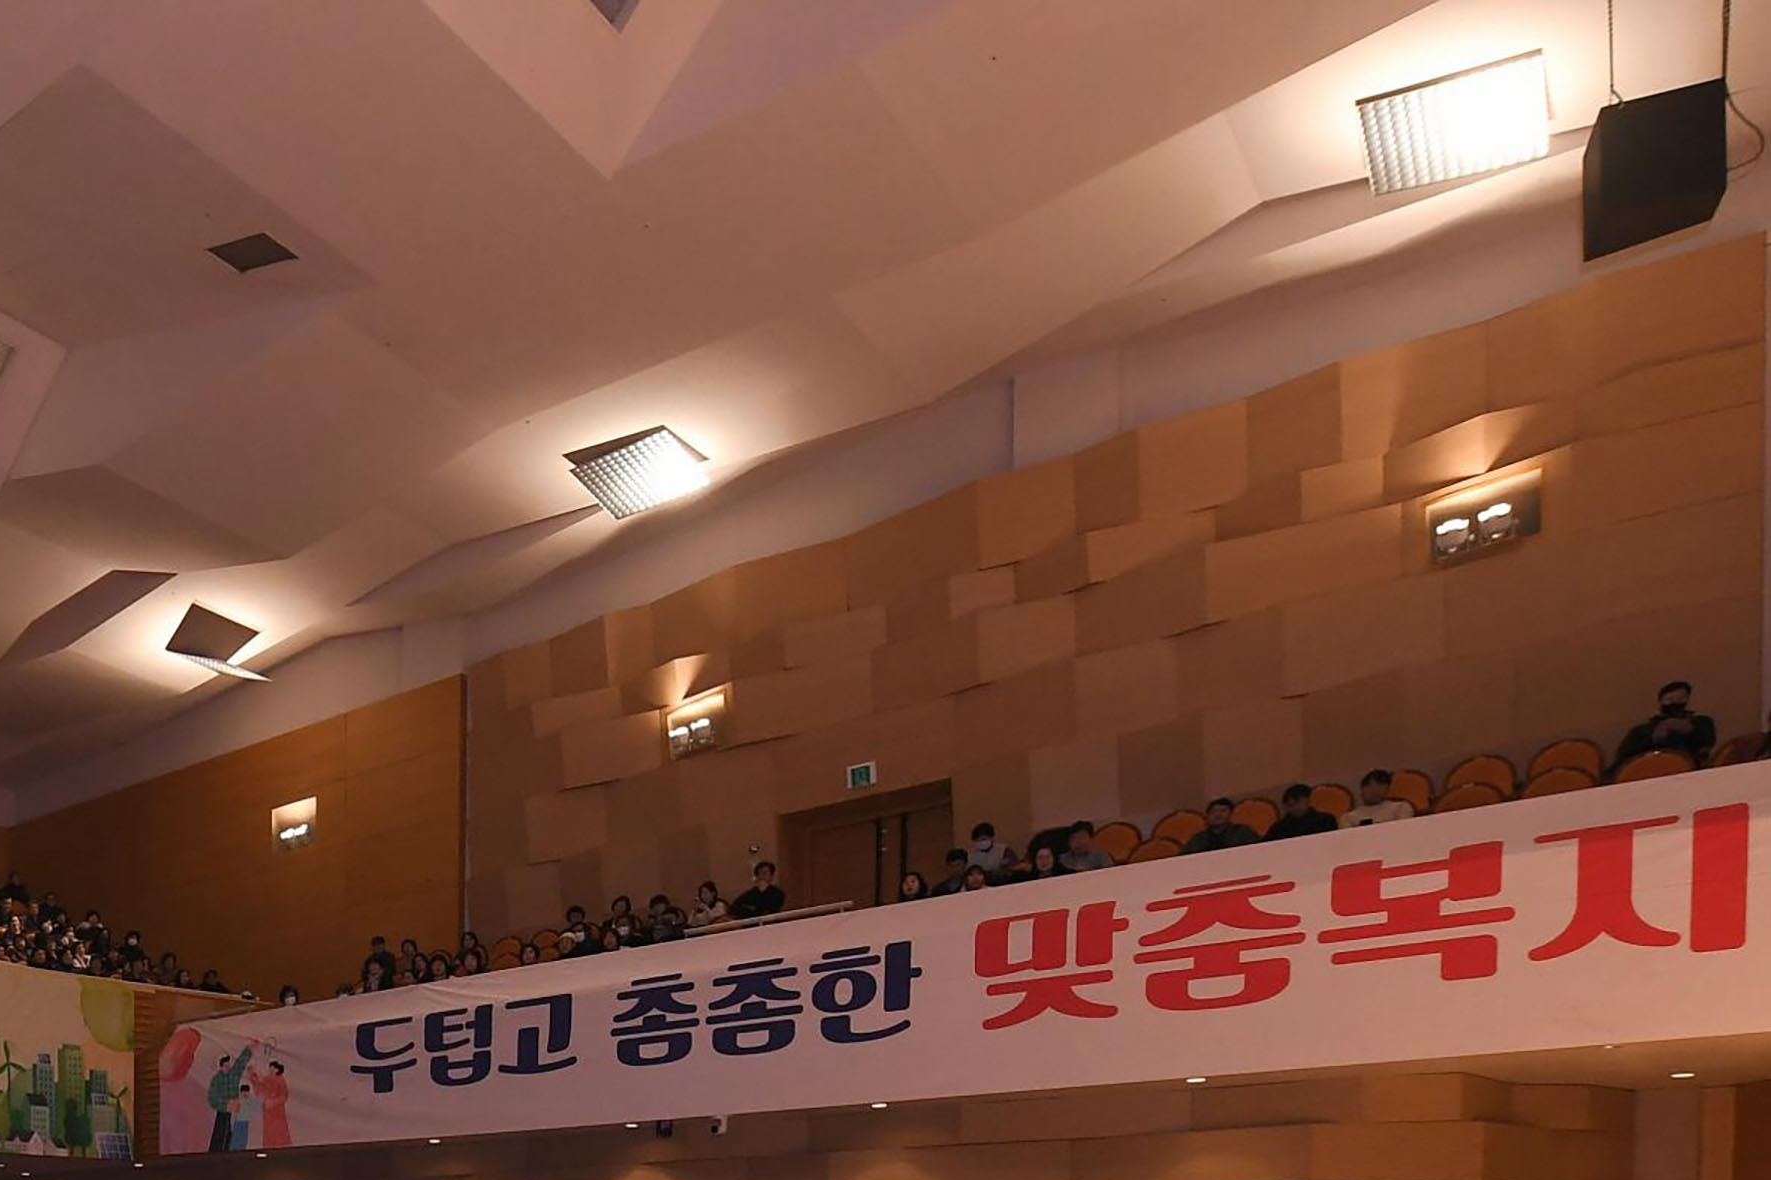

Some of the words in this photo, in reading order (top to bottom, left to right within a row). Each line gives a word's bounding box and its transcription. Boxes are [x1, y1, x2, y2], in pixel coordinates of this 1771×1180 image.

[348, 993, 579, 1094] 두텁고
[610, 940, 923, 1066] 촘촘한
[974, 802, 1752, 1031] 맞춤복지
